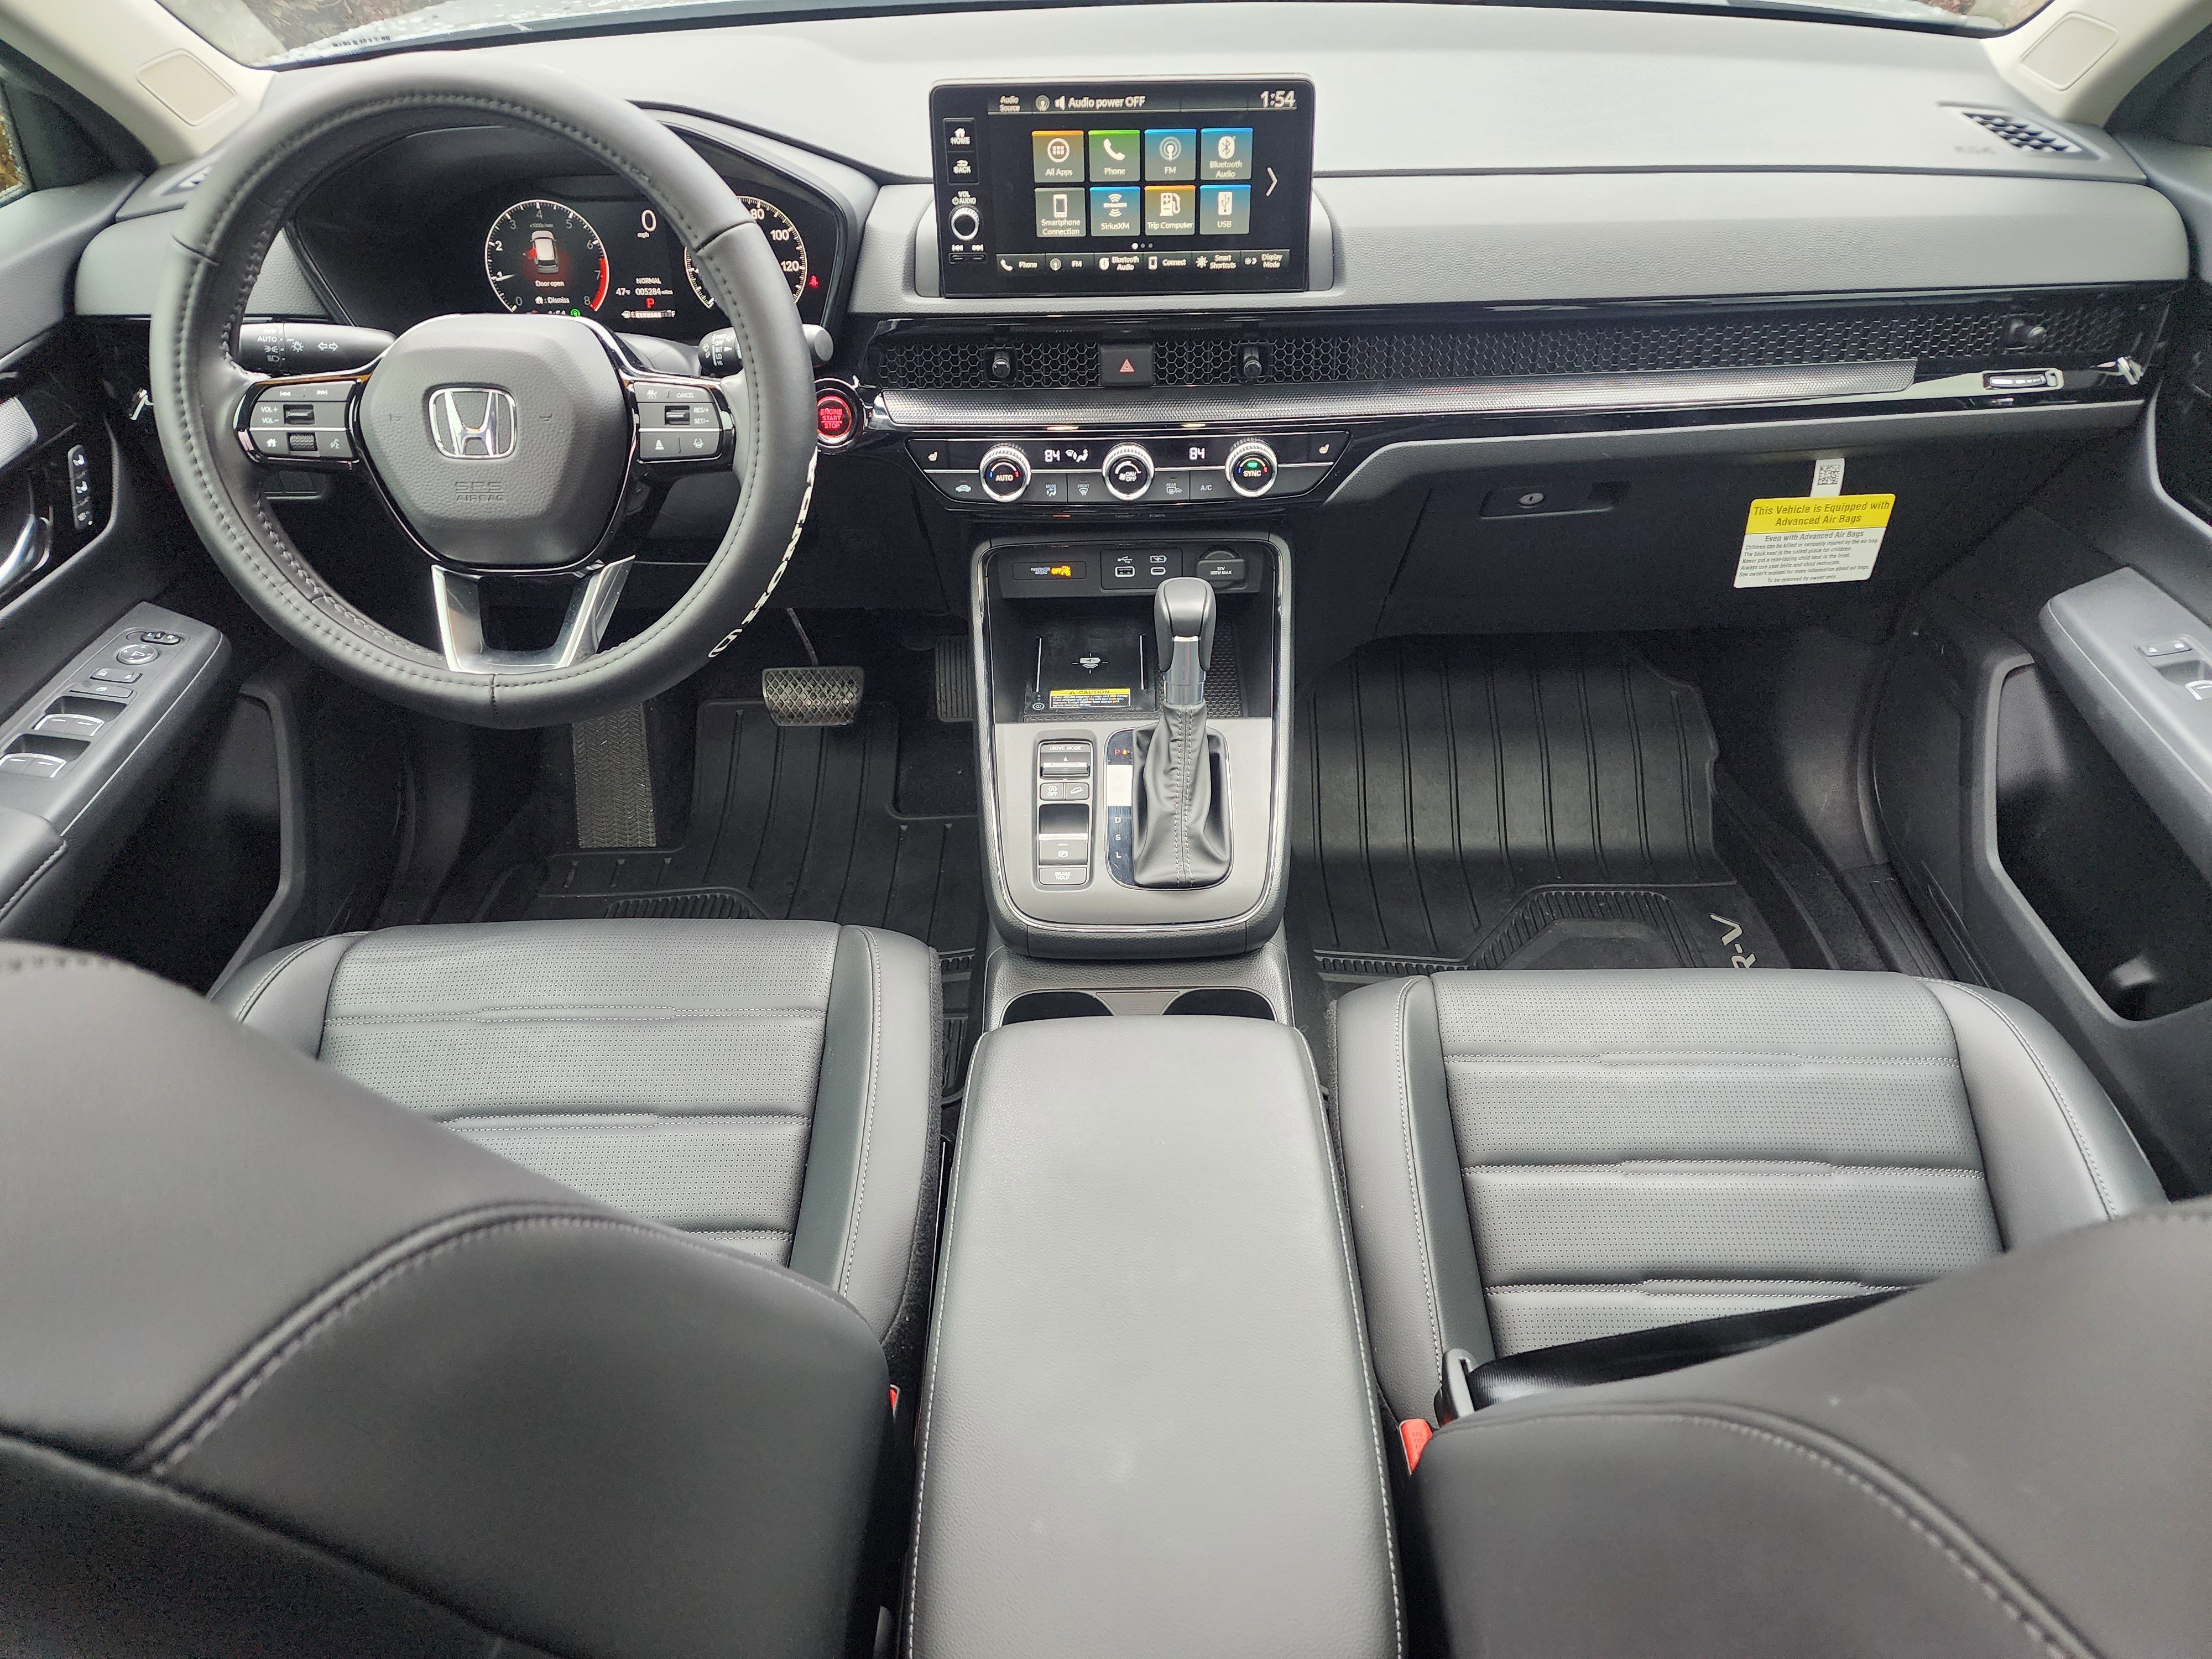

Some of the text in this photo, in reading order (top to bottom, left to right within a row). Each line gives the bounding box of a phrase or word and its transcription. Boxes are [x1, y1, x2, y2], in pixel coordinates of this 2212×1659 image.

[999, 95, 1019, 104] Audio
[1068, 96, 1146, 110] Audio power OFF
[1260, 90, 1296, 108] 1:54
[999, 104, 1020, 112] Source
[950, 136, 971, 145] HOME
[1209, 160, 1243, 169] Bluetooth
[1045, 168, 1073, 178] All Apps
[1104, 167, 1126, 175] Phone
[1165, 166, 1176, 175] FM
[1215, 170, 1235, 179] Audio
[536, 210, 543, 219] 4
[749, 208, 765, 220] 80
[509, 220, 517, 229] 3
[566, 220, 573, 229] 5
[641, 210, 656, 232] 0
[1041, 218, 1081, 228] Smartphone
[1147, 221, 1194, 230] Trip Computer
[1217, 220, 1232, 228] USB
[1100, 222, 1130, 231] SiriusXM
[770, 229, 789, 241] 100
[495, 241, 503, 251] 2
[587, 241, 594, 249] 6
[1111, 255, 1139, 264] Bluetooth
[1261, 253, 1283, 262] Display
[781, 260, 800, 272] 120
[1162, 258, 1187, 267] Connect
[1209, 262, 1237, 270] Shortcuts
[1263, 260, 1280, 269] Mode
[594, 270, 601, 280] 7
[515, 296, 523, 306] 0
[583, 296, 591, 305] 8
[646, 298, 655, 309] P
[1044, 450, 1061, 462] 84
[1189, 447, 1205, 460] 84
[1754, 500, 1890, 515] This Vehicle is Equipped with
[1775, 515, 1862, 526] Advanced Air Bags
[1799, 532, 1833, 540] Advanced
